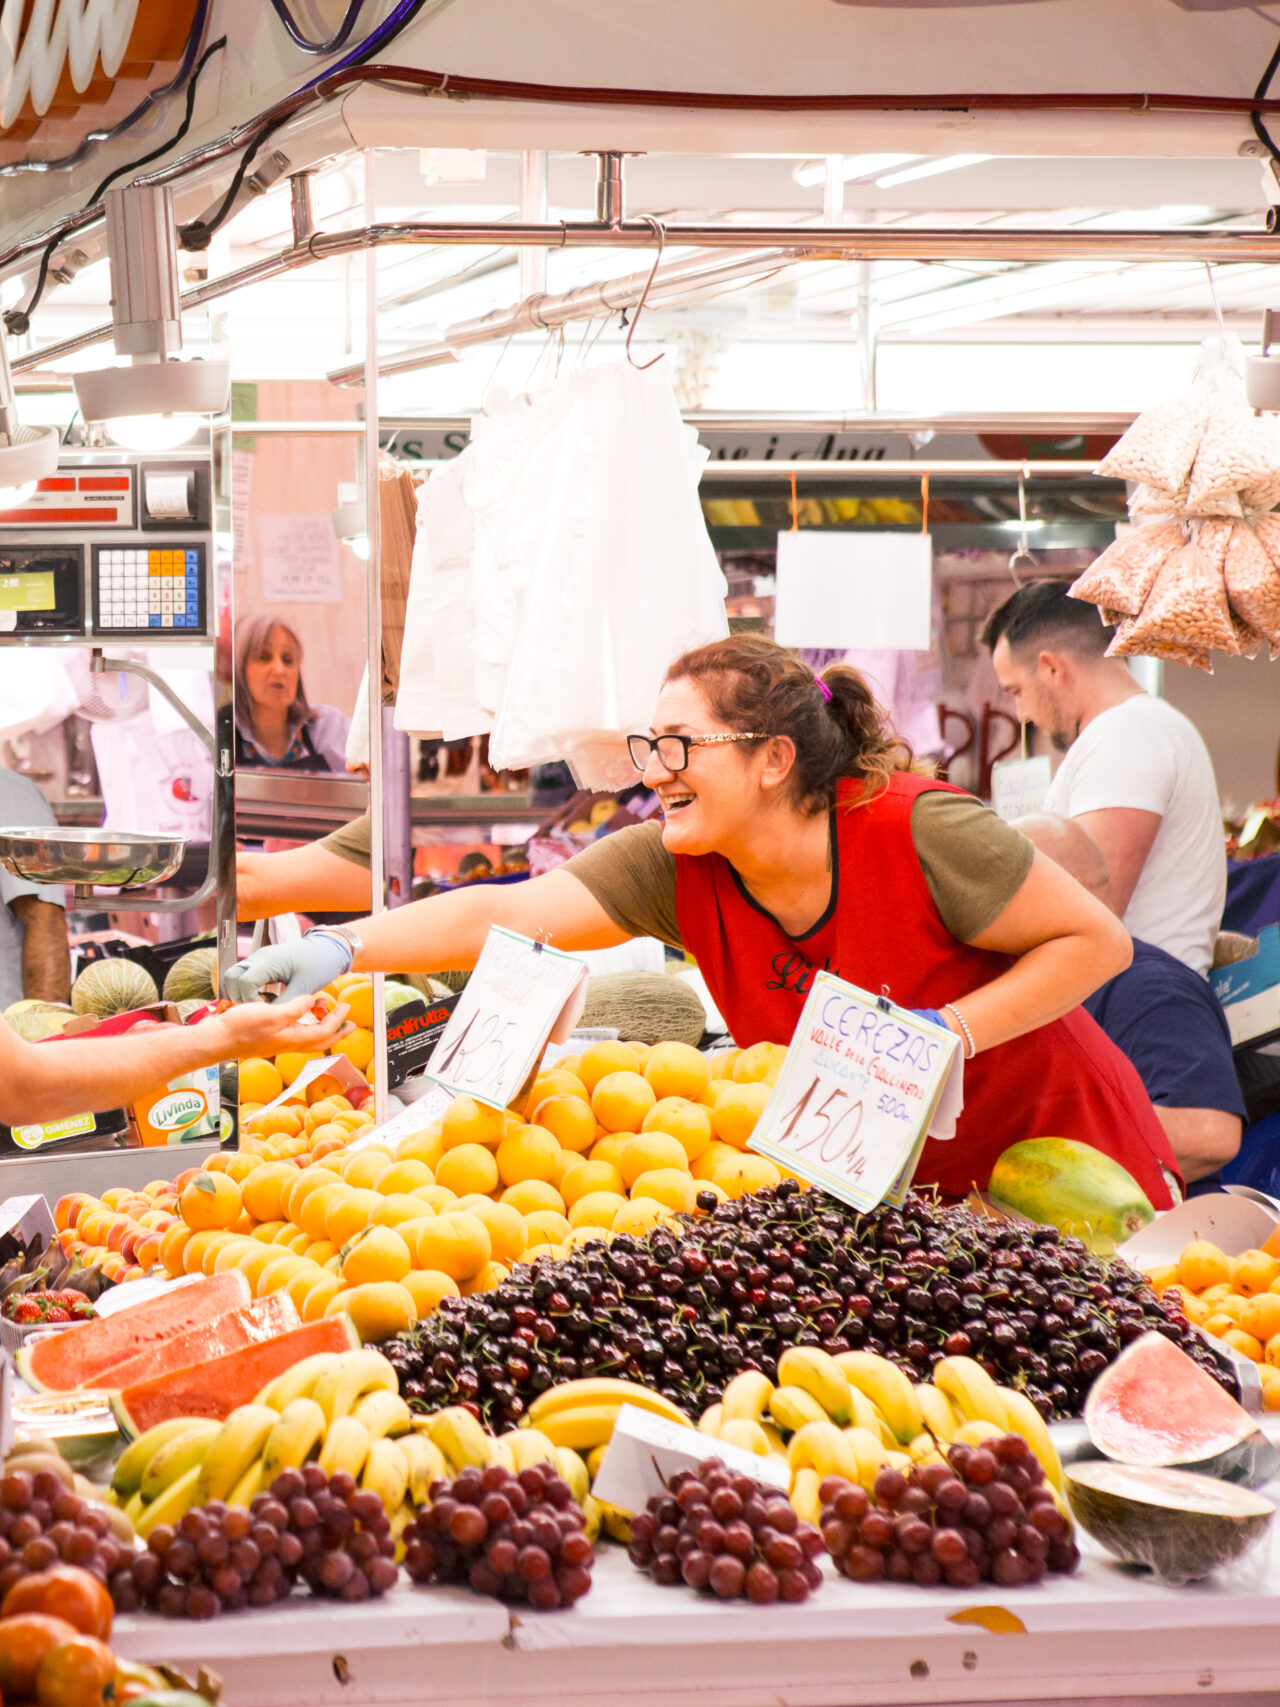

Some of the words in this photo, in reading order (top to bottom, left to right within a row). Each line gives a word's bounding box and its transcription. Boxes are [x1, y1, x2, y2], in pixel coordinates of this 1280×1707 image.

[386, 1007, 452, 1040] anifrutta
[810, 1027, 844, 1053] VALLE
[822, 996, 939, 1072] CEREZAS
